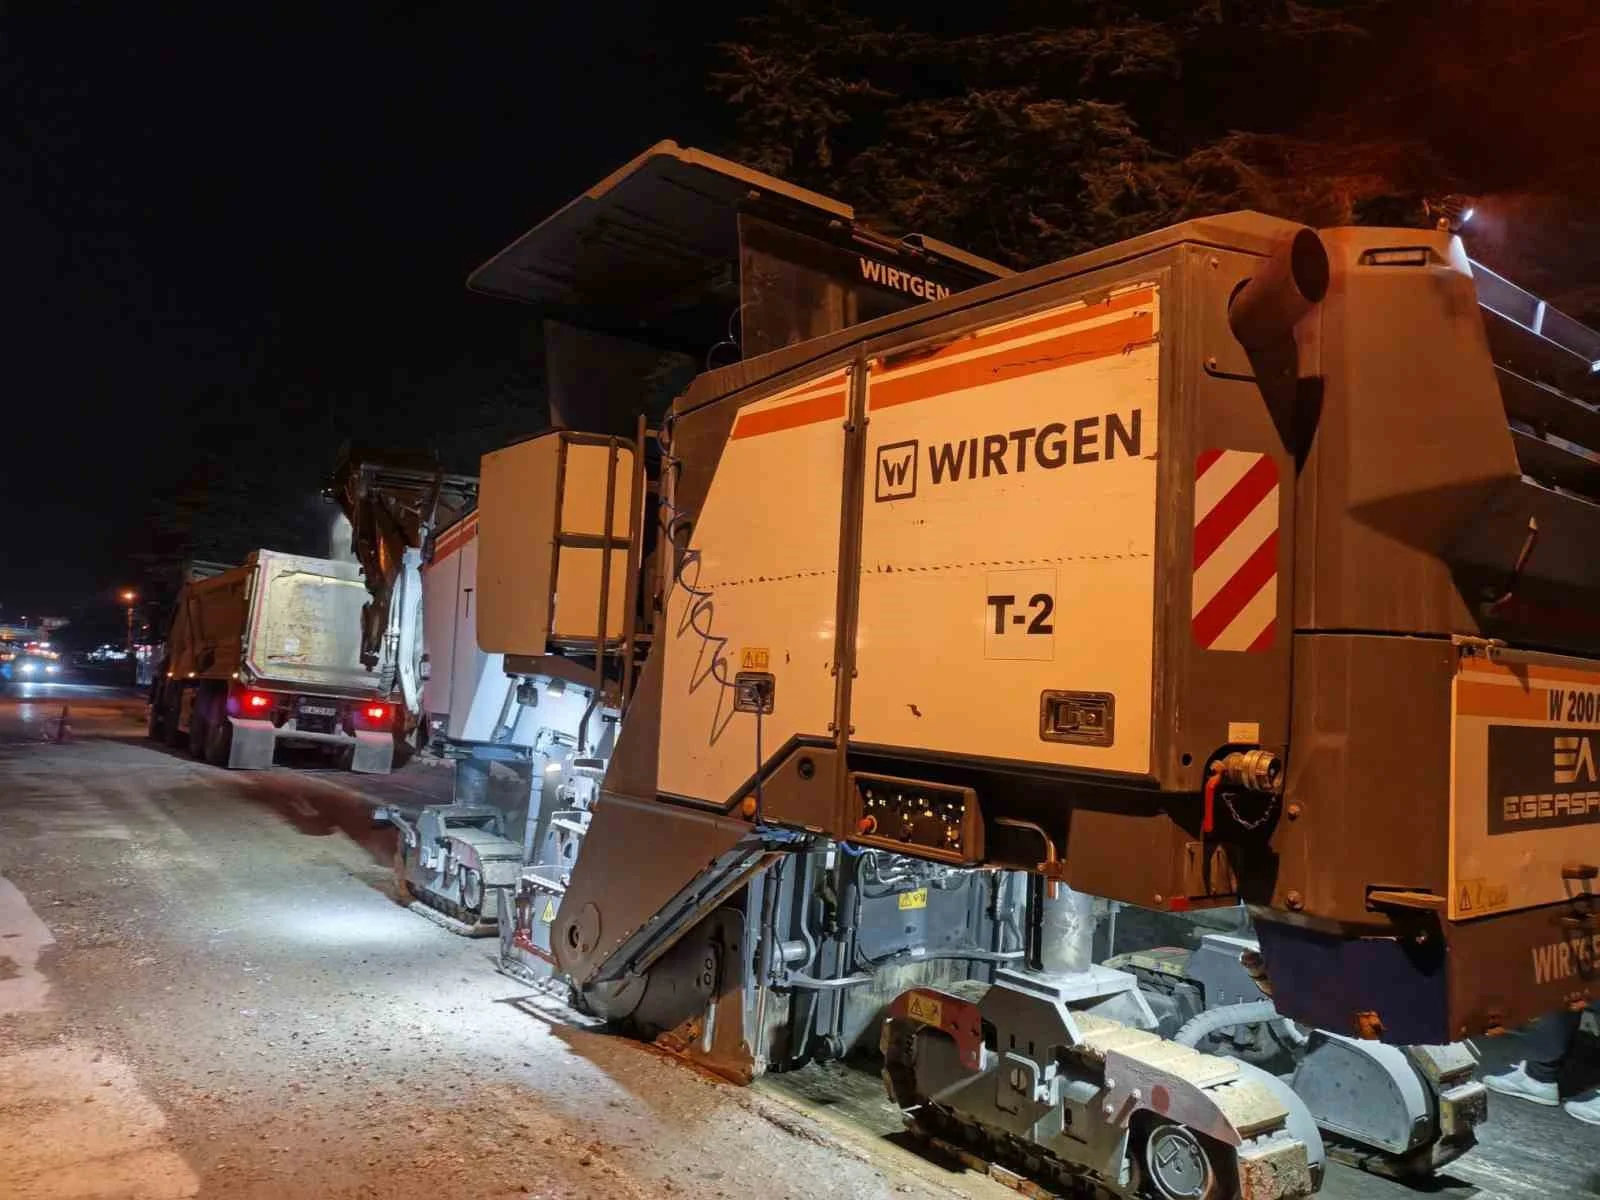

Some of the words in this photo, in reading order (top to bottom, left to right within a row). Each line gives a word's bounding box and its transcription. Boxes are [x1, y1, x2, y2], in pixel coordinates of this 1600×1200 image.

[860, 257, 950, 301] WIRTGEN
[928, 409, 1141, 485] WIRTGEN
[987, 593, 1053, 635] T-2
[1549, 688, 1564, 721] W
